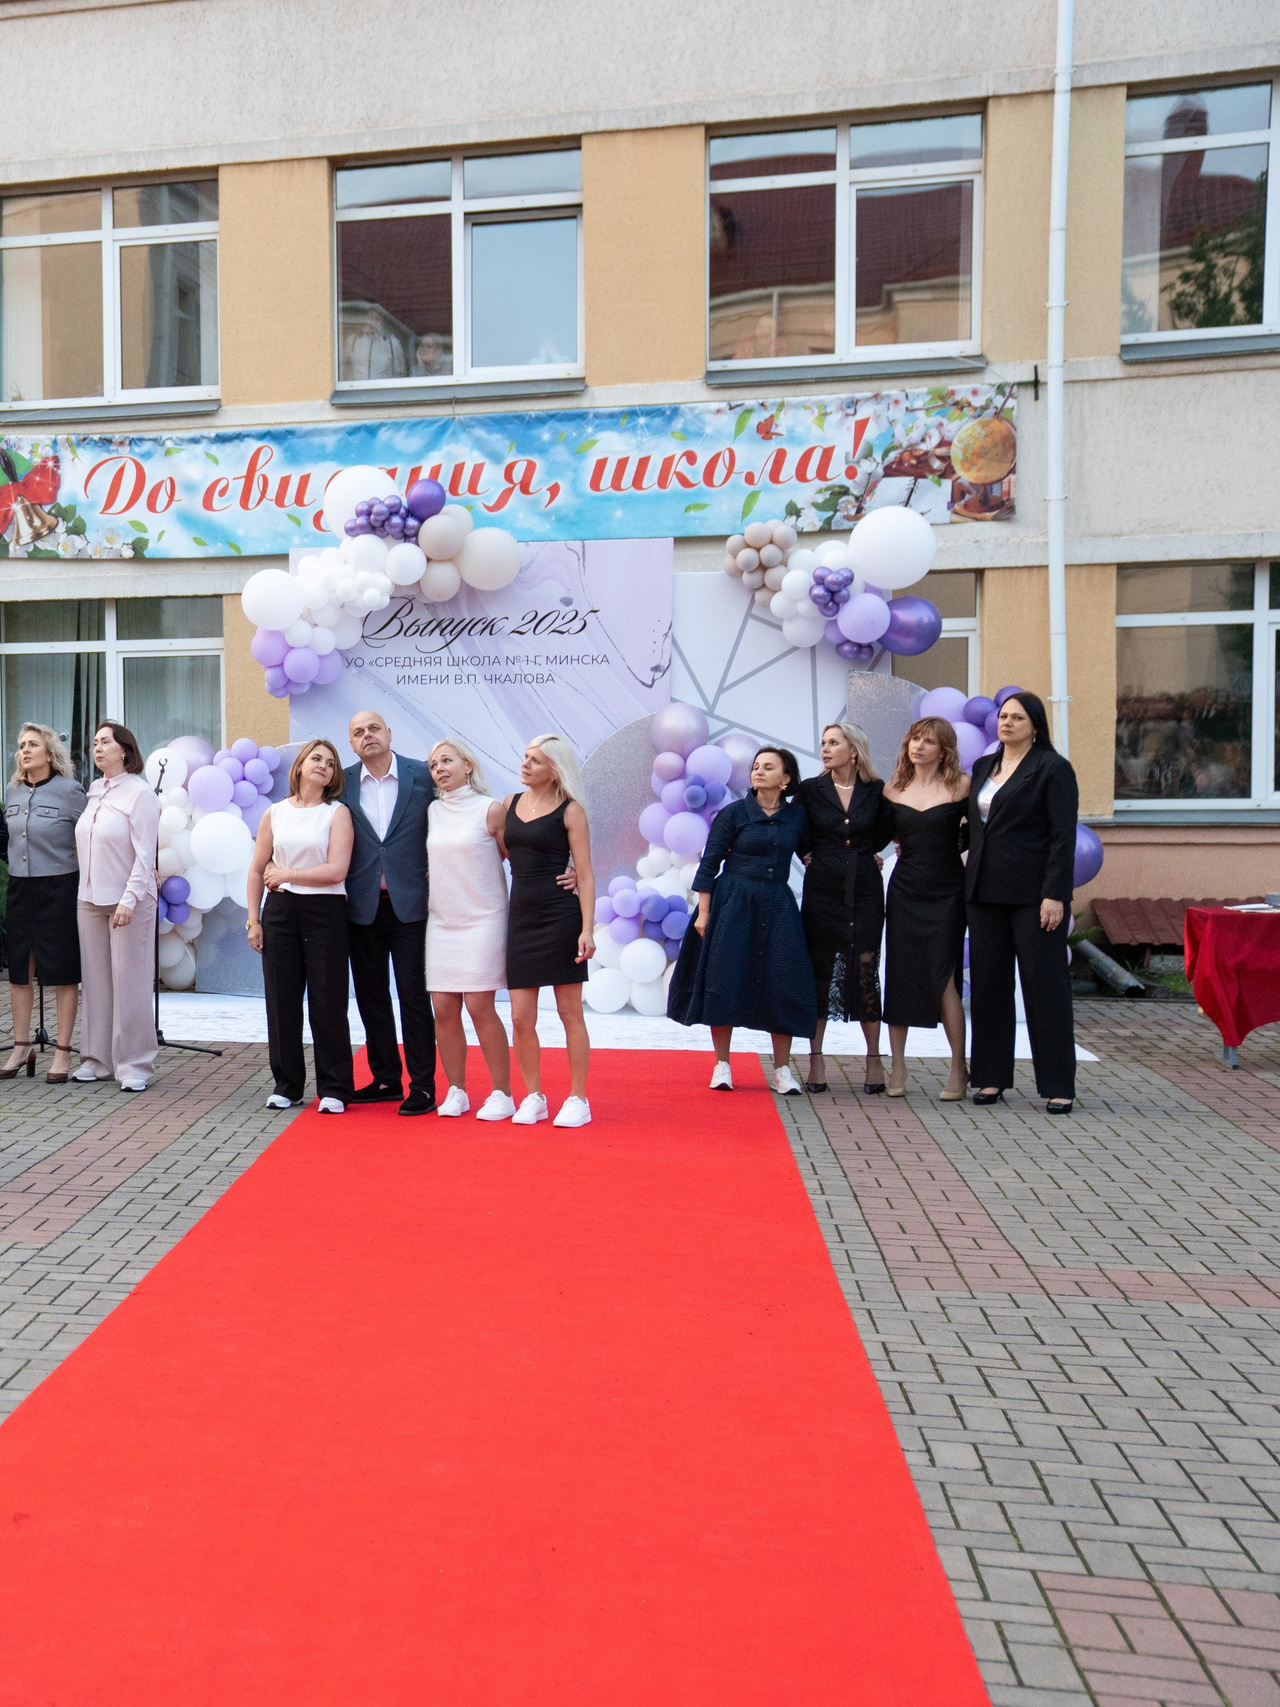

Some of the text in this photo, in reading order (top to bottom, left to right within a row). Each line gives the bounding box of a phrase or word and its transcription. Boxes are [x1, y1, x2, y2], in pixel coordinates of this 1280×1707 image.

[83, 455, 183, 516] До
[588, 416, 872, 493] школа!
[361, 596, 600, 654] Выпуск 2025
[345, 656, 365, 668] УО
[368, 656, 442, 669] «СРЕДНЯЯ
[446, 655, 502, 667] ШКОЛА
[545, 654, 610, 666] МИНСКА
[396, 673, 556, 685] ИМЕНИ В.П. ЧКАЛОВА
